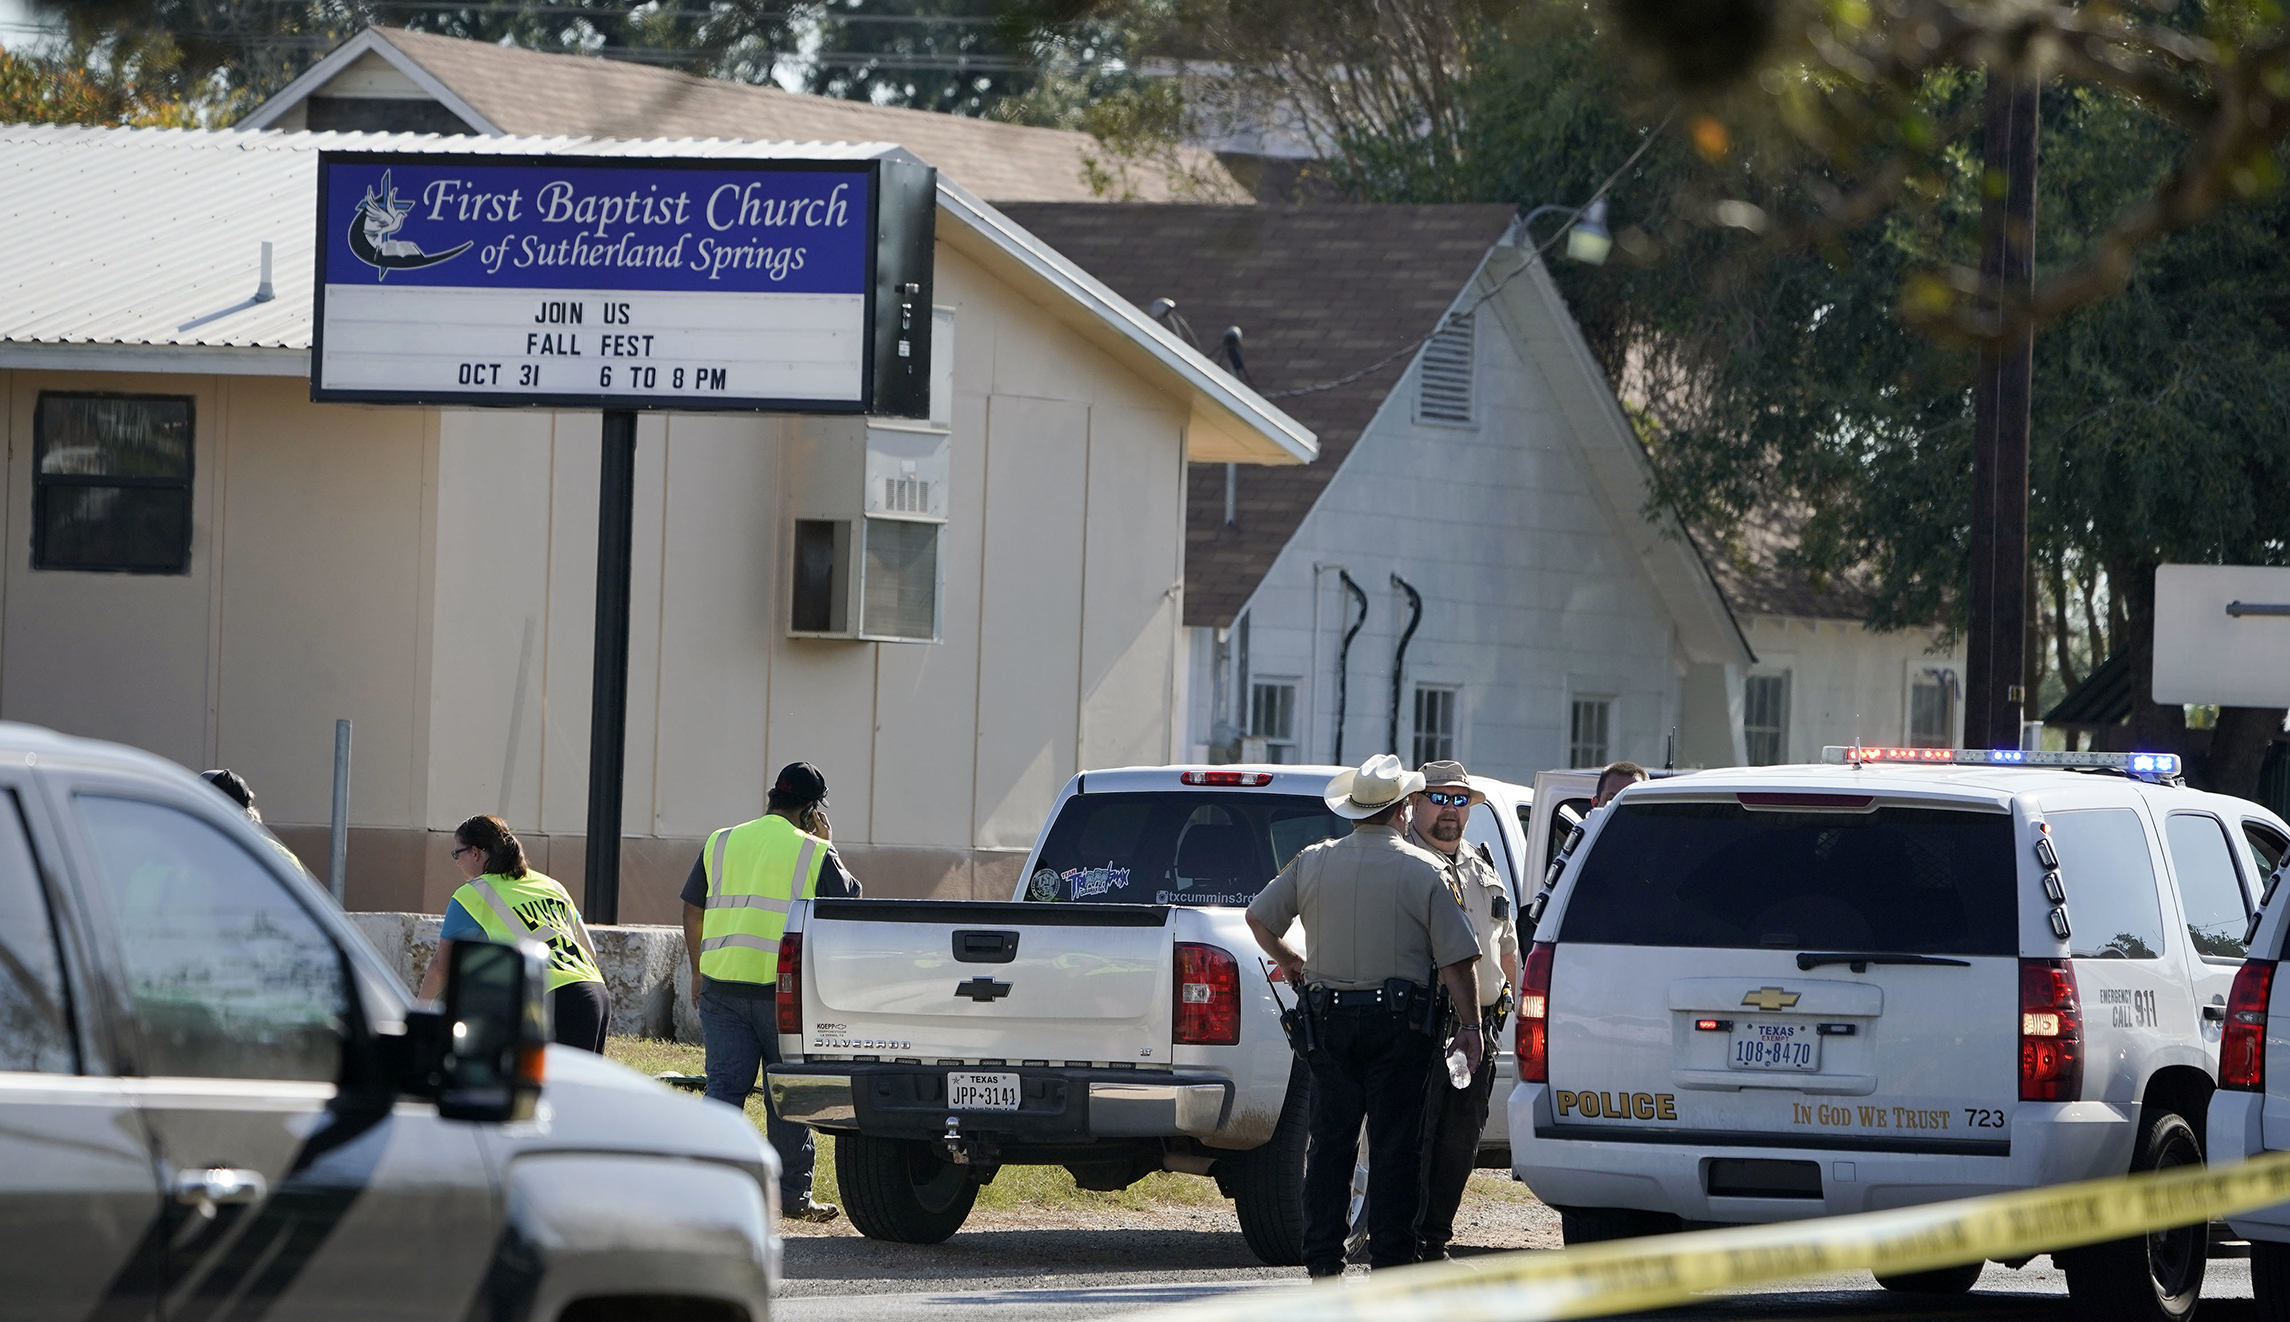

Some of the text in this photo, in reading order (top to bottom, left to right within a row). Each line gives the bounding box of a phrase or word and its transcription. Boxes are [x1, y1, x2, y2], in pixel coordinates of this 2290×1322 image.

[423, 179, 848, 238] First Baptist Church
[480, 231, 806, 281] of Sutherland Springs
[534, 302, 630, 324] JOIN US
[526, 333, 654, 356] FALL FEST
[458, 363, 726, 390] OCT 31 6 TO 8 PM
[2100, 989, 2132, 1004] EMERGENCY
[2112, 1006, 2133, 1028] CALL
[1759, 1026, 1794, 1036] TEXAS
[814, 1038, 911, 1050] SILVERADO
[1556, 1090, 1678, 1120] POLICE
[1965, 1109, 2004, 1127] 723
